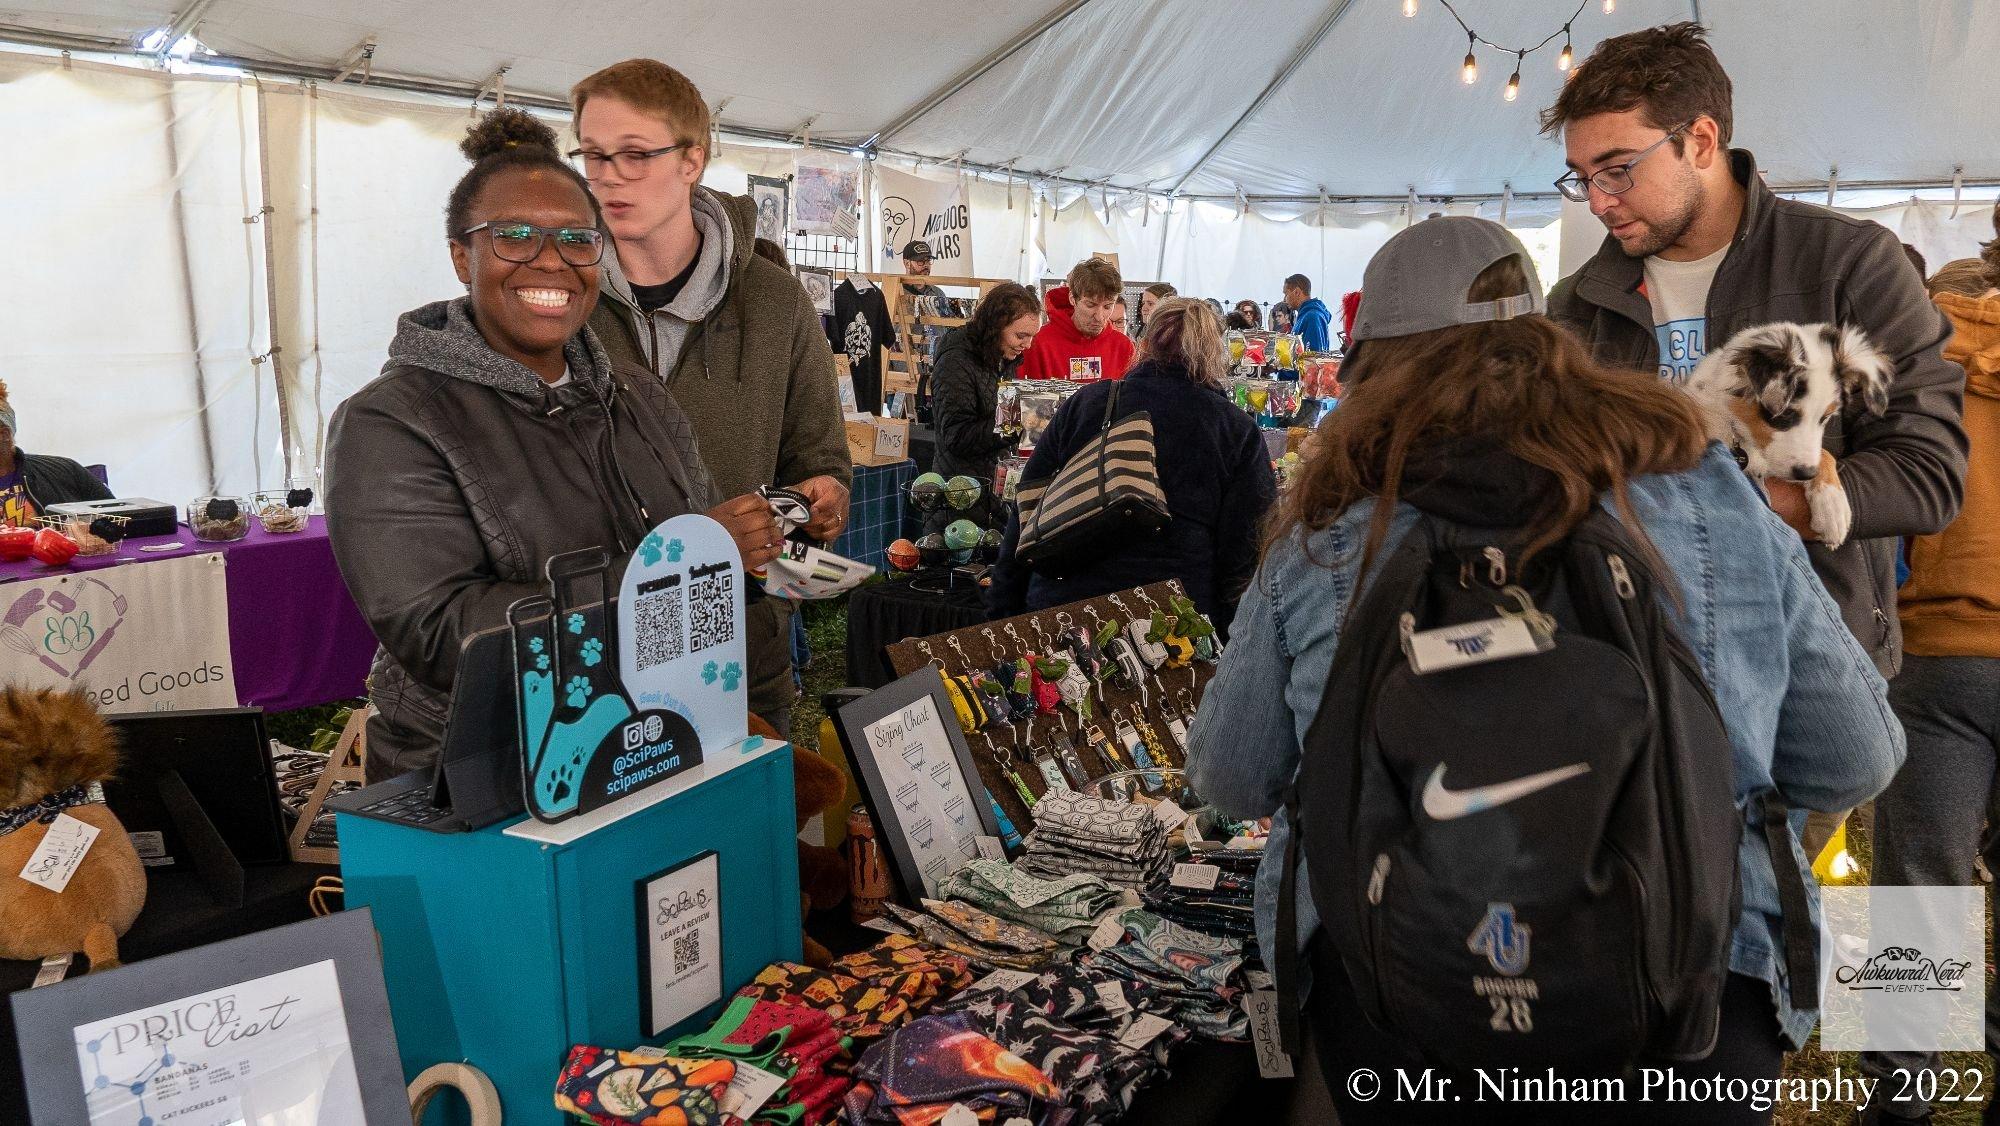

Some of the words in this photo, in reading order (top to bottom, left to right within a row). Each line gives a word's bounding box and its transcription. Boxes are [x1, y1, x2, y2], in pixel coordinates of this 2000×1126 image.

[943, 204, 968, 231] DOG
[138, 660, 224, 696] Goods
[874, 722, 905, 750] Sizing
[903, 705, 930, 733] Chart
[606, 754, 680, 795] scipaws.com
[612, 738, 674, 776] @SciPaws
[660, 924, 681, 942] LEAVE
[681, 921, 688, 932] A
[687, 911, 711, 930] REVIEW
[110, 994, 241, 1056] PRICE
[203, 995, 301, 1048] list
[154, 1062, 209, 1085] BANDANAS
[161, 1110, 178, 1121] CAT
[180, 1097, 216, 1115] KICKERS
